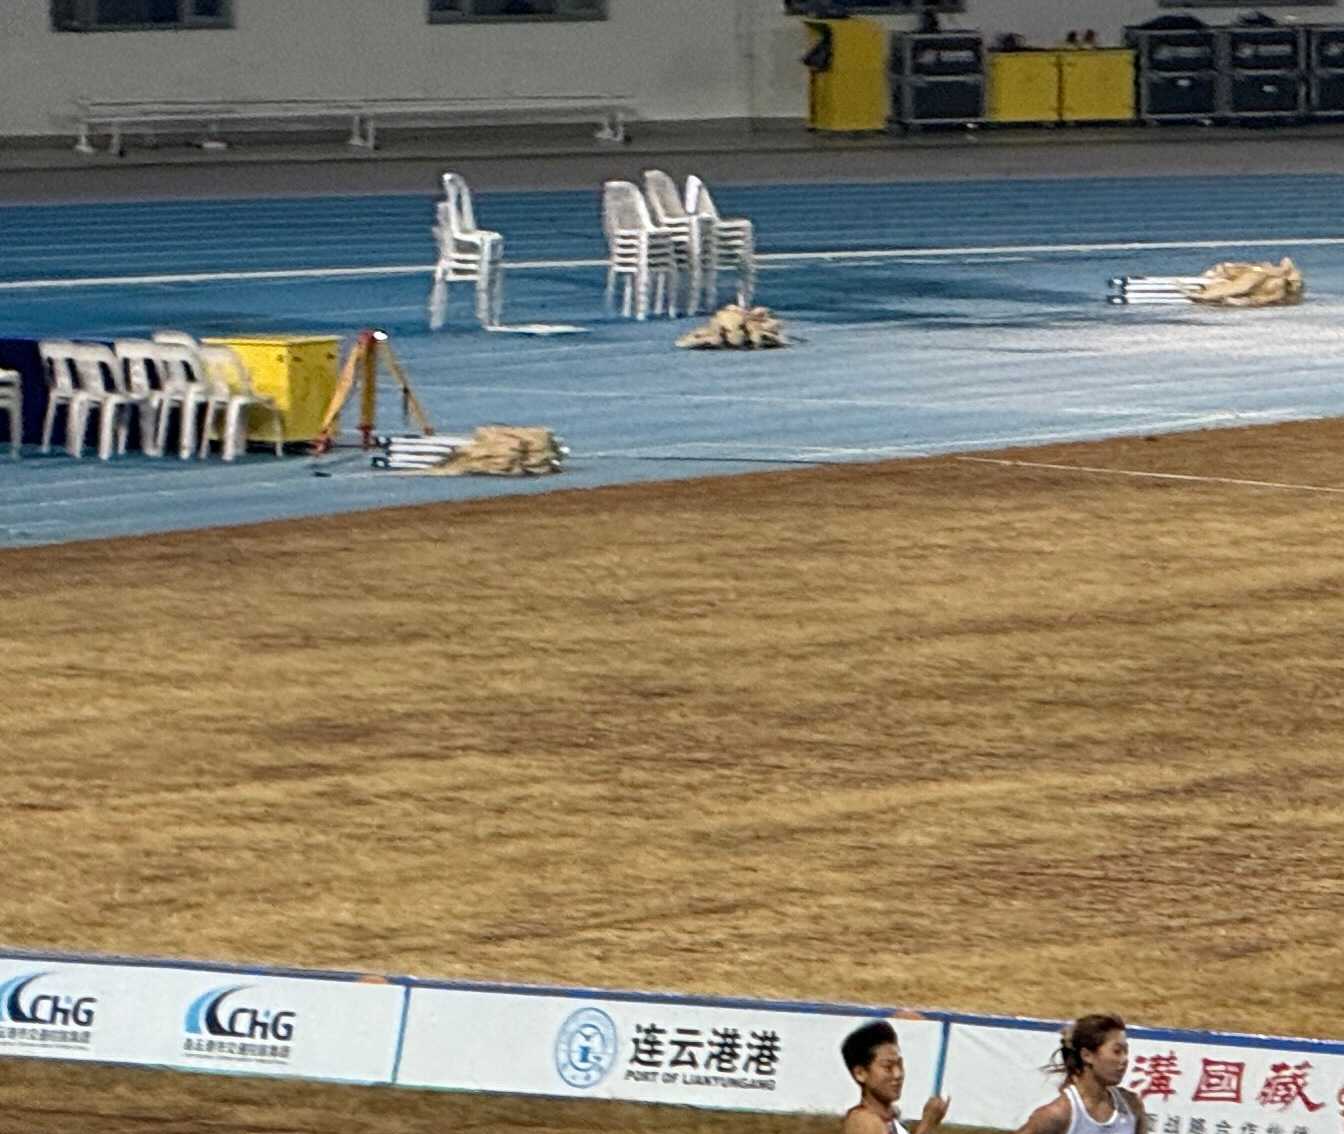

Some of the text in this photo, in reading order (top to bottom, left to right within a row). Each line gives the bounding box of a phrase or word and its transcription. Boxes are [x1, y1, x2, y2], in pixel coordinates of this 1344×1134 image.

[30, 994, 98, 1027] CHG
[228, 1007, 296, 1041] CHG
[629, 1023, 782, 1076] 连云港港
[625, 1069, 659, 1082] PORT
[662, 1072, 679, 1084] OF
[1128, 1051, 1326, 1112] 溝國藏
